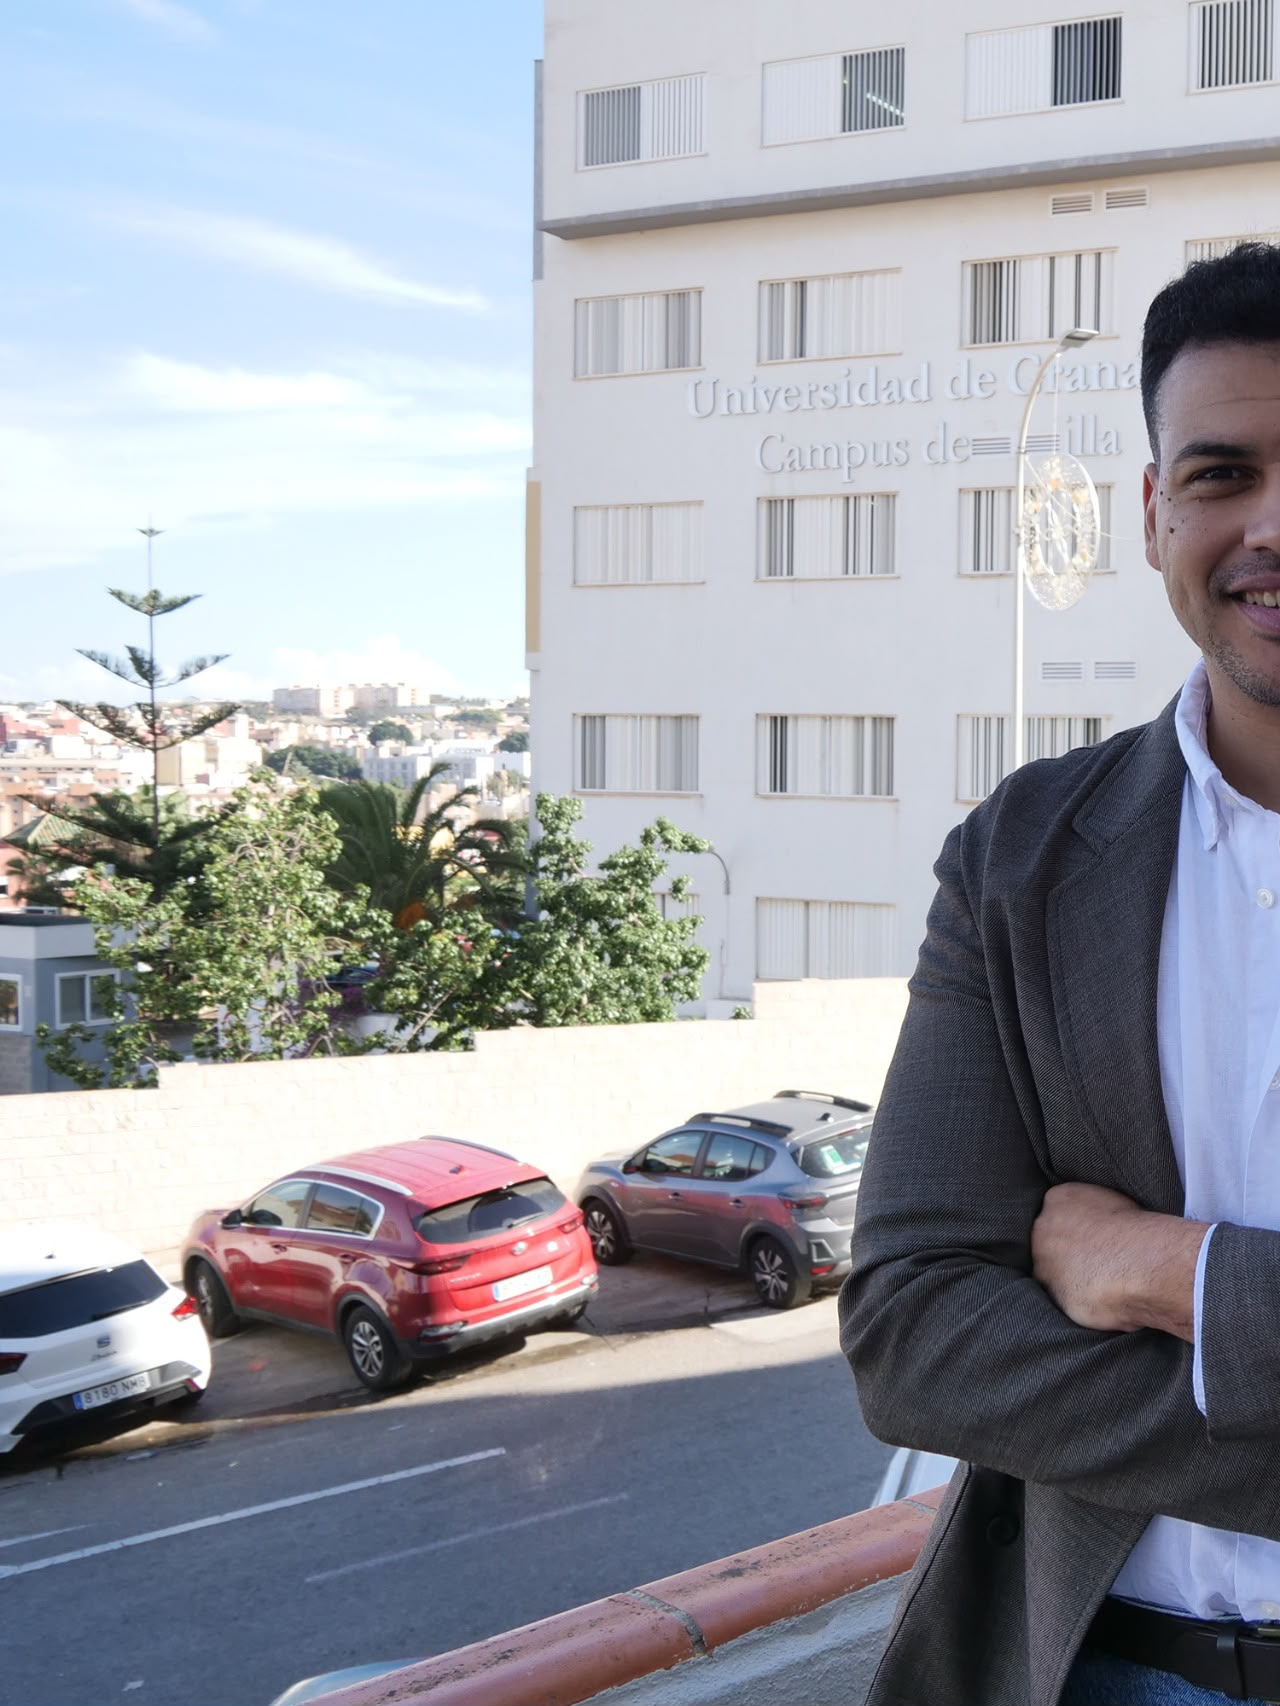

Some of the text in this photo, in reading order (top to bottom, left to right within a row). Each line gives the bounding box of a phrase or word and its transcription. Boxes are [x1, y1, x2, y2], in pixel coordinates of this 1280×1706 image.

[687, 353, 1141, 418] Universidad de Grana
[755, 432, 910, 484] Campus
[922, 420, 971, 465] de
